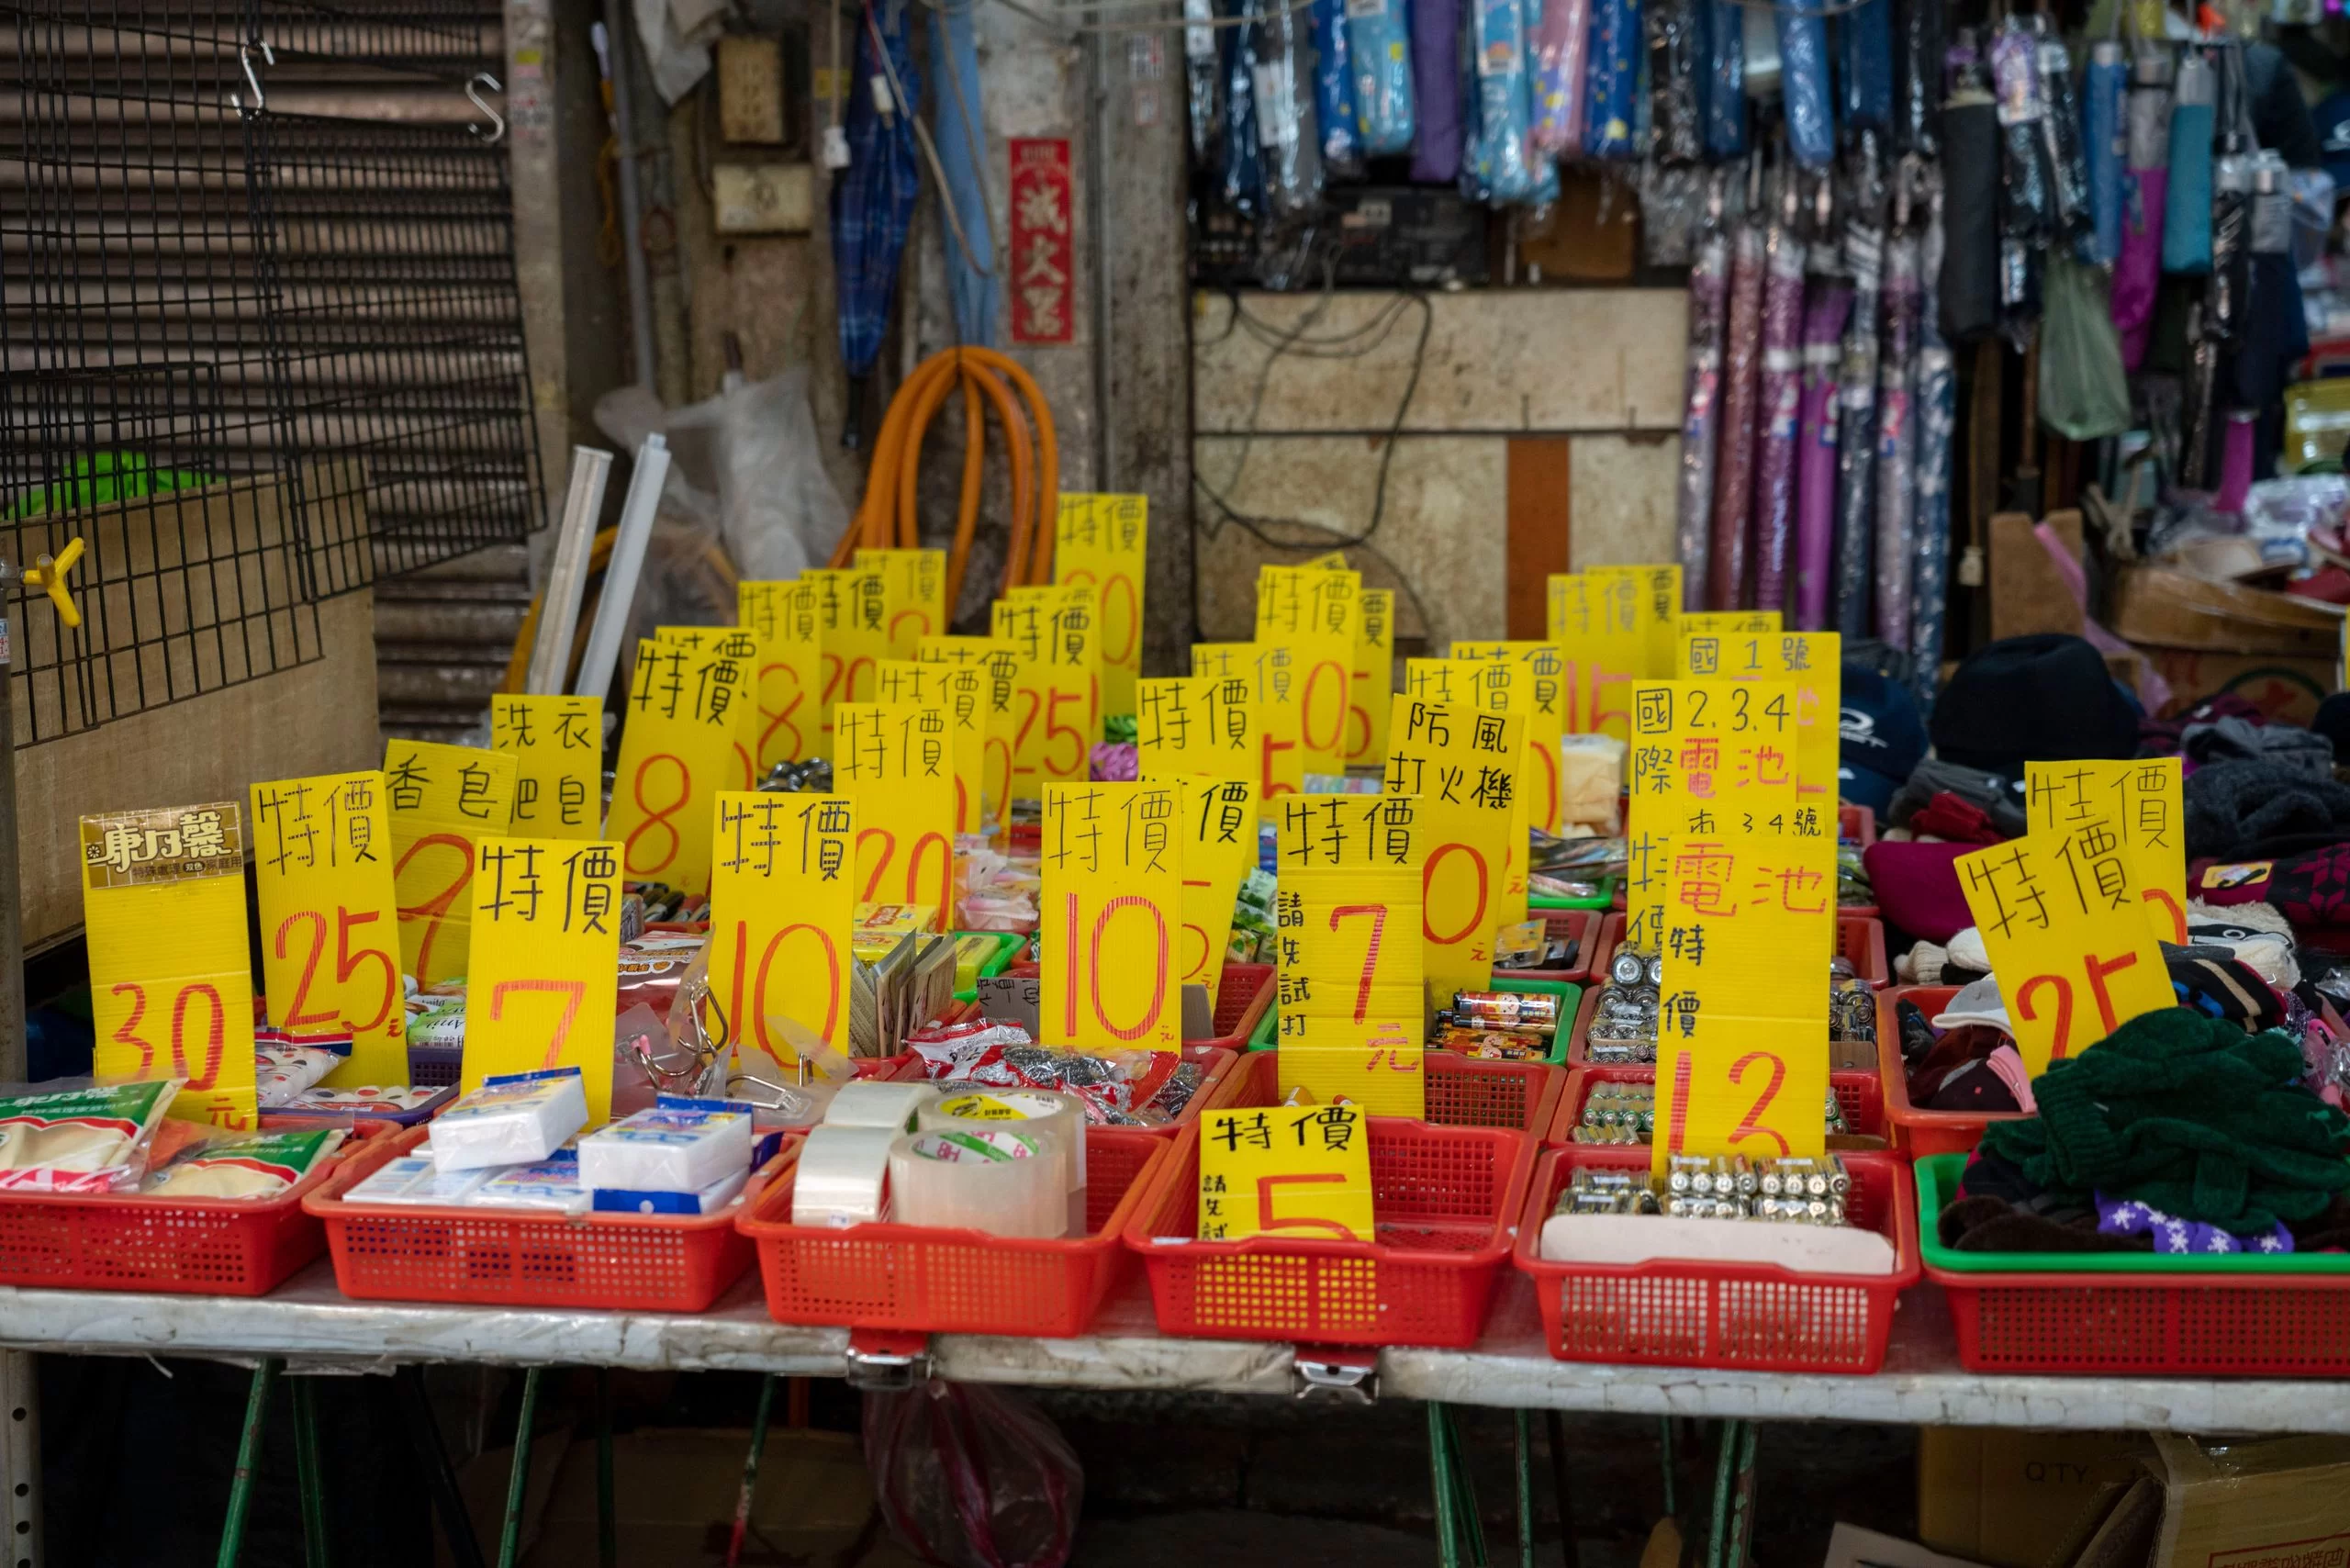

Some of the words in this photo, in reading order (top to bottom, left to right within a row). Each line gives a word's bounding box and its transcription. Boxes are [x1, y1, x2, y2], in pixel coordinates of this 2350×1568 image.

[1015, 185, 1068, 338] 滅火器
[1059, 498, 1142, 553] 特價
[741, 585, 817, 644] 特價
[999, 605, 1090, 666] 特價
[1260, 571, 1353, 635] 特價
[1551, 578, 1638, 635] 特價
[497, 702, 592, 750] 洗衣
[633, 645, 738, 726] 特價
[1141, 678, 1250, 751] 特價
[1302, 659, 1348, 752] 0
[839, 708, 944, 780] 特價
[1013, 685, 1085, 777] 25
[1407, 701, 1507, 755] 防風
[1680, 737, 1790, 800] 電池
[388, 753, 491, 819] 香皂
[624, 754, 691, 876] 8
[1386, 751, 1514, 810] 打火機
[2031, 764, 2169, 849] 特價
[87, 811, 232, 874] 康乃馨
[258, 778, 377, 876] 特價
[721, 798, 852, 881] 特價
[1048, 789, 1172, 874] 特價
[1286, 797, 1414, 867] 特價
[393, 833, 476, 993] 9
[478, 844, 618, 935] 特價
[856, 828, 954, 934] 20
[1423, 843, 1489, 945] 0
[1673, 842, 1827, 918] 電池
[1967, 820, 2132, 940] 特價
[274, 902, 397, 1034] 25
[730, 920, 841, 1070] 10
[1064, 891, 1169, 1042] 10
[1277, 892, 1311, 1036] 請先試打
[1328, 903, 1389, 1025] 7
[1662, 924, 1705, 1039] 特價
[110, 981, 225, 1091] 30
[489, 979, 588, 1072] 7
[1365, 1023, 1419, 1073] 元
[1211, 1105, 1358, 1152] 特價
[1256, 1172, 1359, 1241] 5
